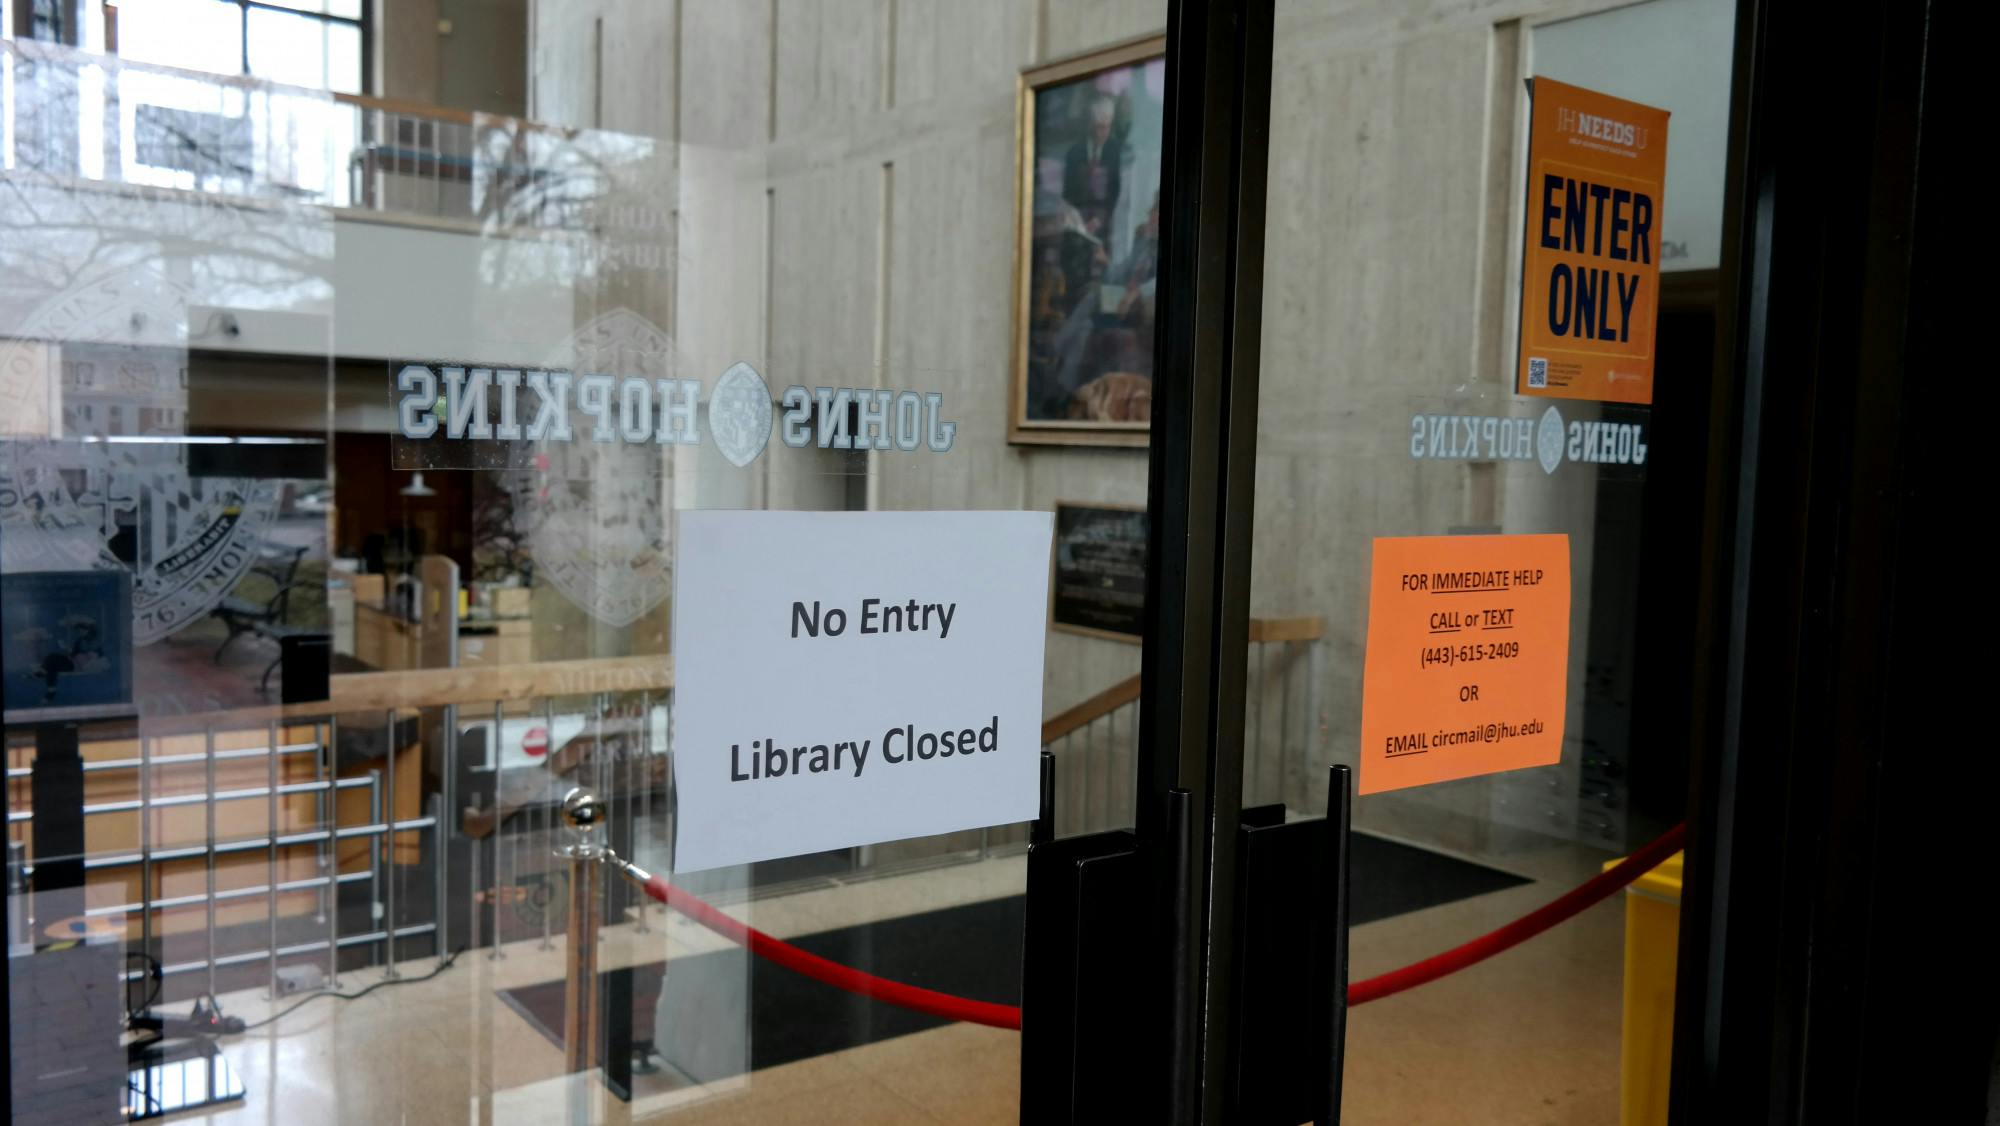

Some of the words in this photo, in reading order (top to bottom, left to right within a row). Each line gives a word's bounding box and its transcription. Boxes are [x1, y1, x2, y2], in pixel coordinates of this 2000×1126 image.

[1541, 174, 1653, 265] ENTER
[1549, 263, 1640, 343] ONLY
[1402, 574, 1428, 591] FOR
[1431, 570, 1510, 592] IMMEDIATE
[1513, 569, 1543, 586] HELP
[791, 601, 847, 638] No
[860, 598, 956, 638] Entry
[1430, 611, 1461, 630] CALL
[1465, 613, 1479, 627] or
[1482, 609, 1514, 626] TEXT
[1421, 642, 1519, 669] (443)-615-2409
[1459, 685, 1479, 702] OR
[731, 738, 870, 782] Library
[882, 715, 999, 764] Closed
[1385, 733, 1428, 754] EMAIL
[1431, 718, 1544, 749] circmail@jhu.edu
